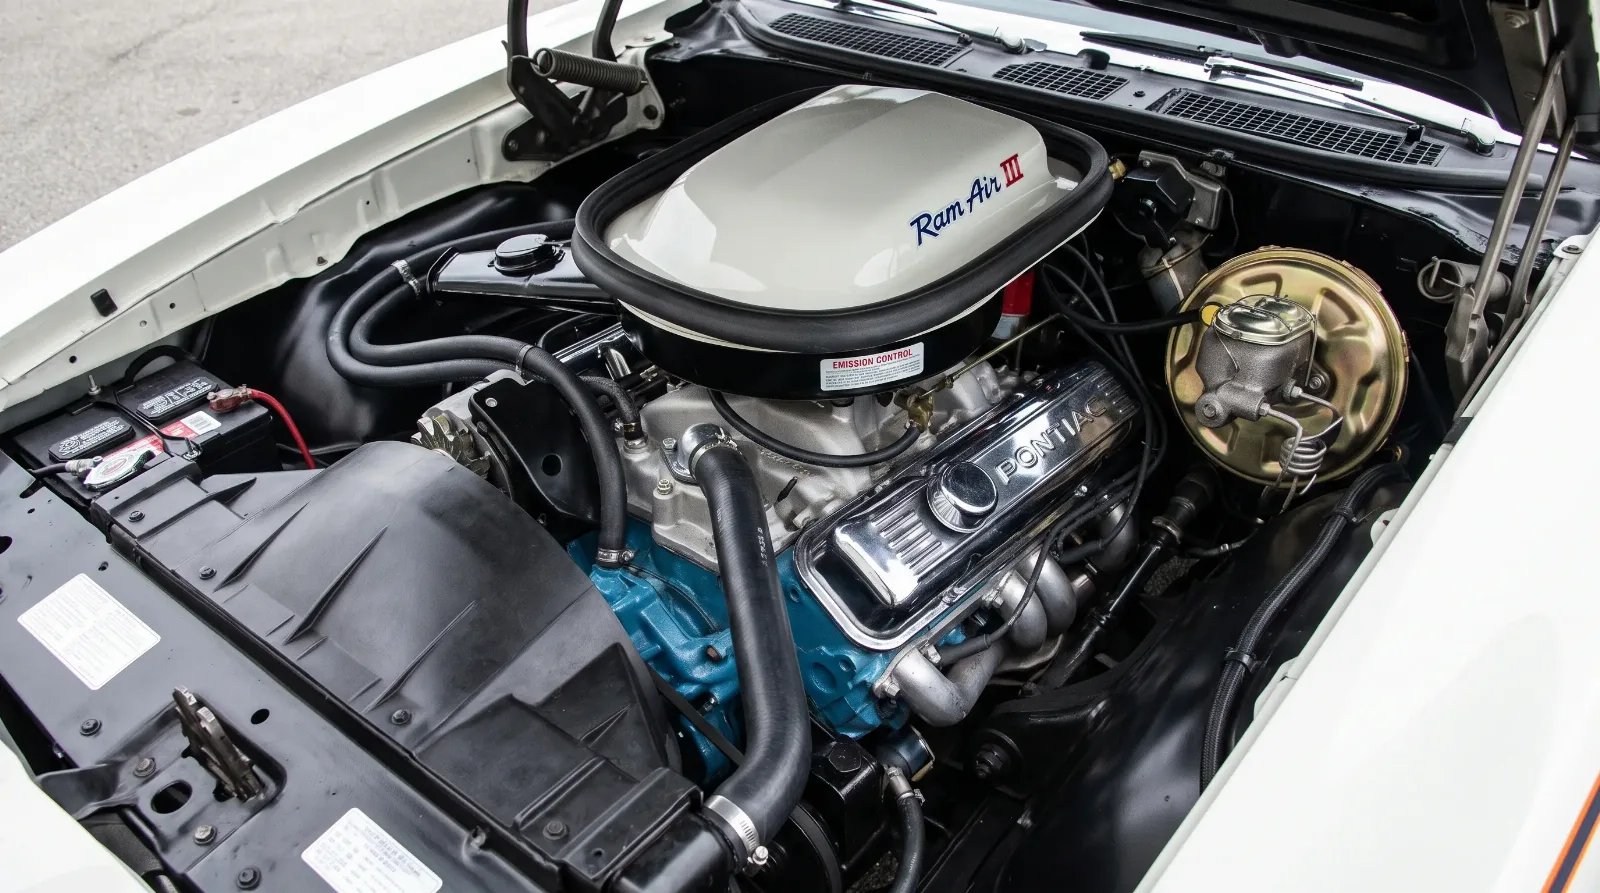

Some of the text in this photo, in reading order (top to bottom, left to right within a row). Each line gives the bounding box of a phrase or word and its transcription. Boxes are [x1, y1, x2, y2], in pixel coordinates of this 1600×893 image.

[909, 153, 1025, 246] Ram Air III
[832, 348, 913, 369] EMISSION CONTROL
[994, 396, 1108, 486] PONTIAC
